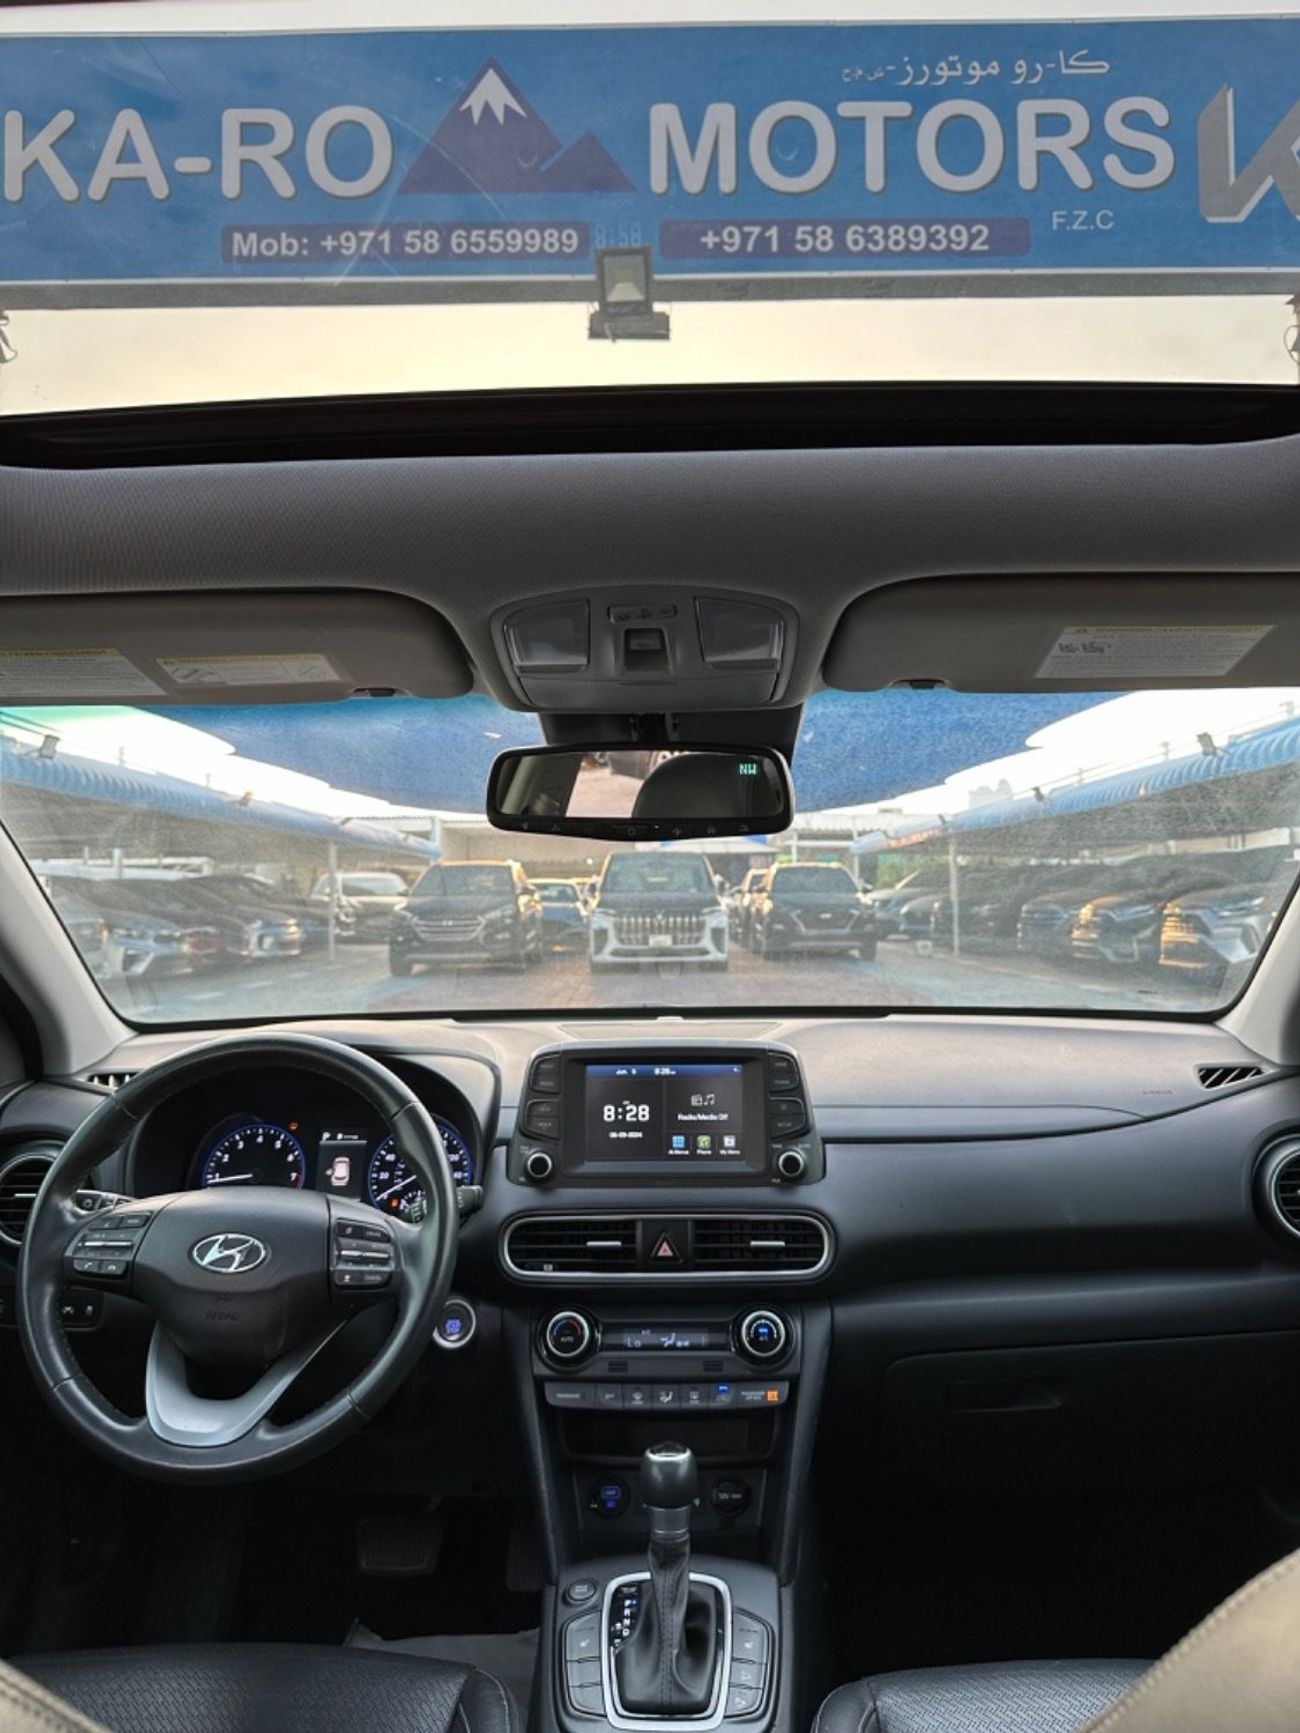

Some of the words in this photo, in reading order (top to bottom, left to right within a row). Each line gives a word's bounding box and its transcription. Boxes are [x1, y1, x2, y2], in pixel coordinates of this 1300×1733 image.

[4, 105, 395, 203] KA-RO
[649, 96, 1176, 196] MOTORS
[231, 231, 309, 258] Mob:
[320, 230, 392, 257] +971
[403, 230, 440, 256] 58
[451, 228, 579, 255] 6559989
[700, 226, 780, 254] +971
[795, 225, 835, 253] 58
[845, 224, 990, 252] 6389392
[739, 762, 757, 775] NW
[603, 1104, 650, 1122] 8:28
